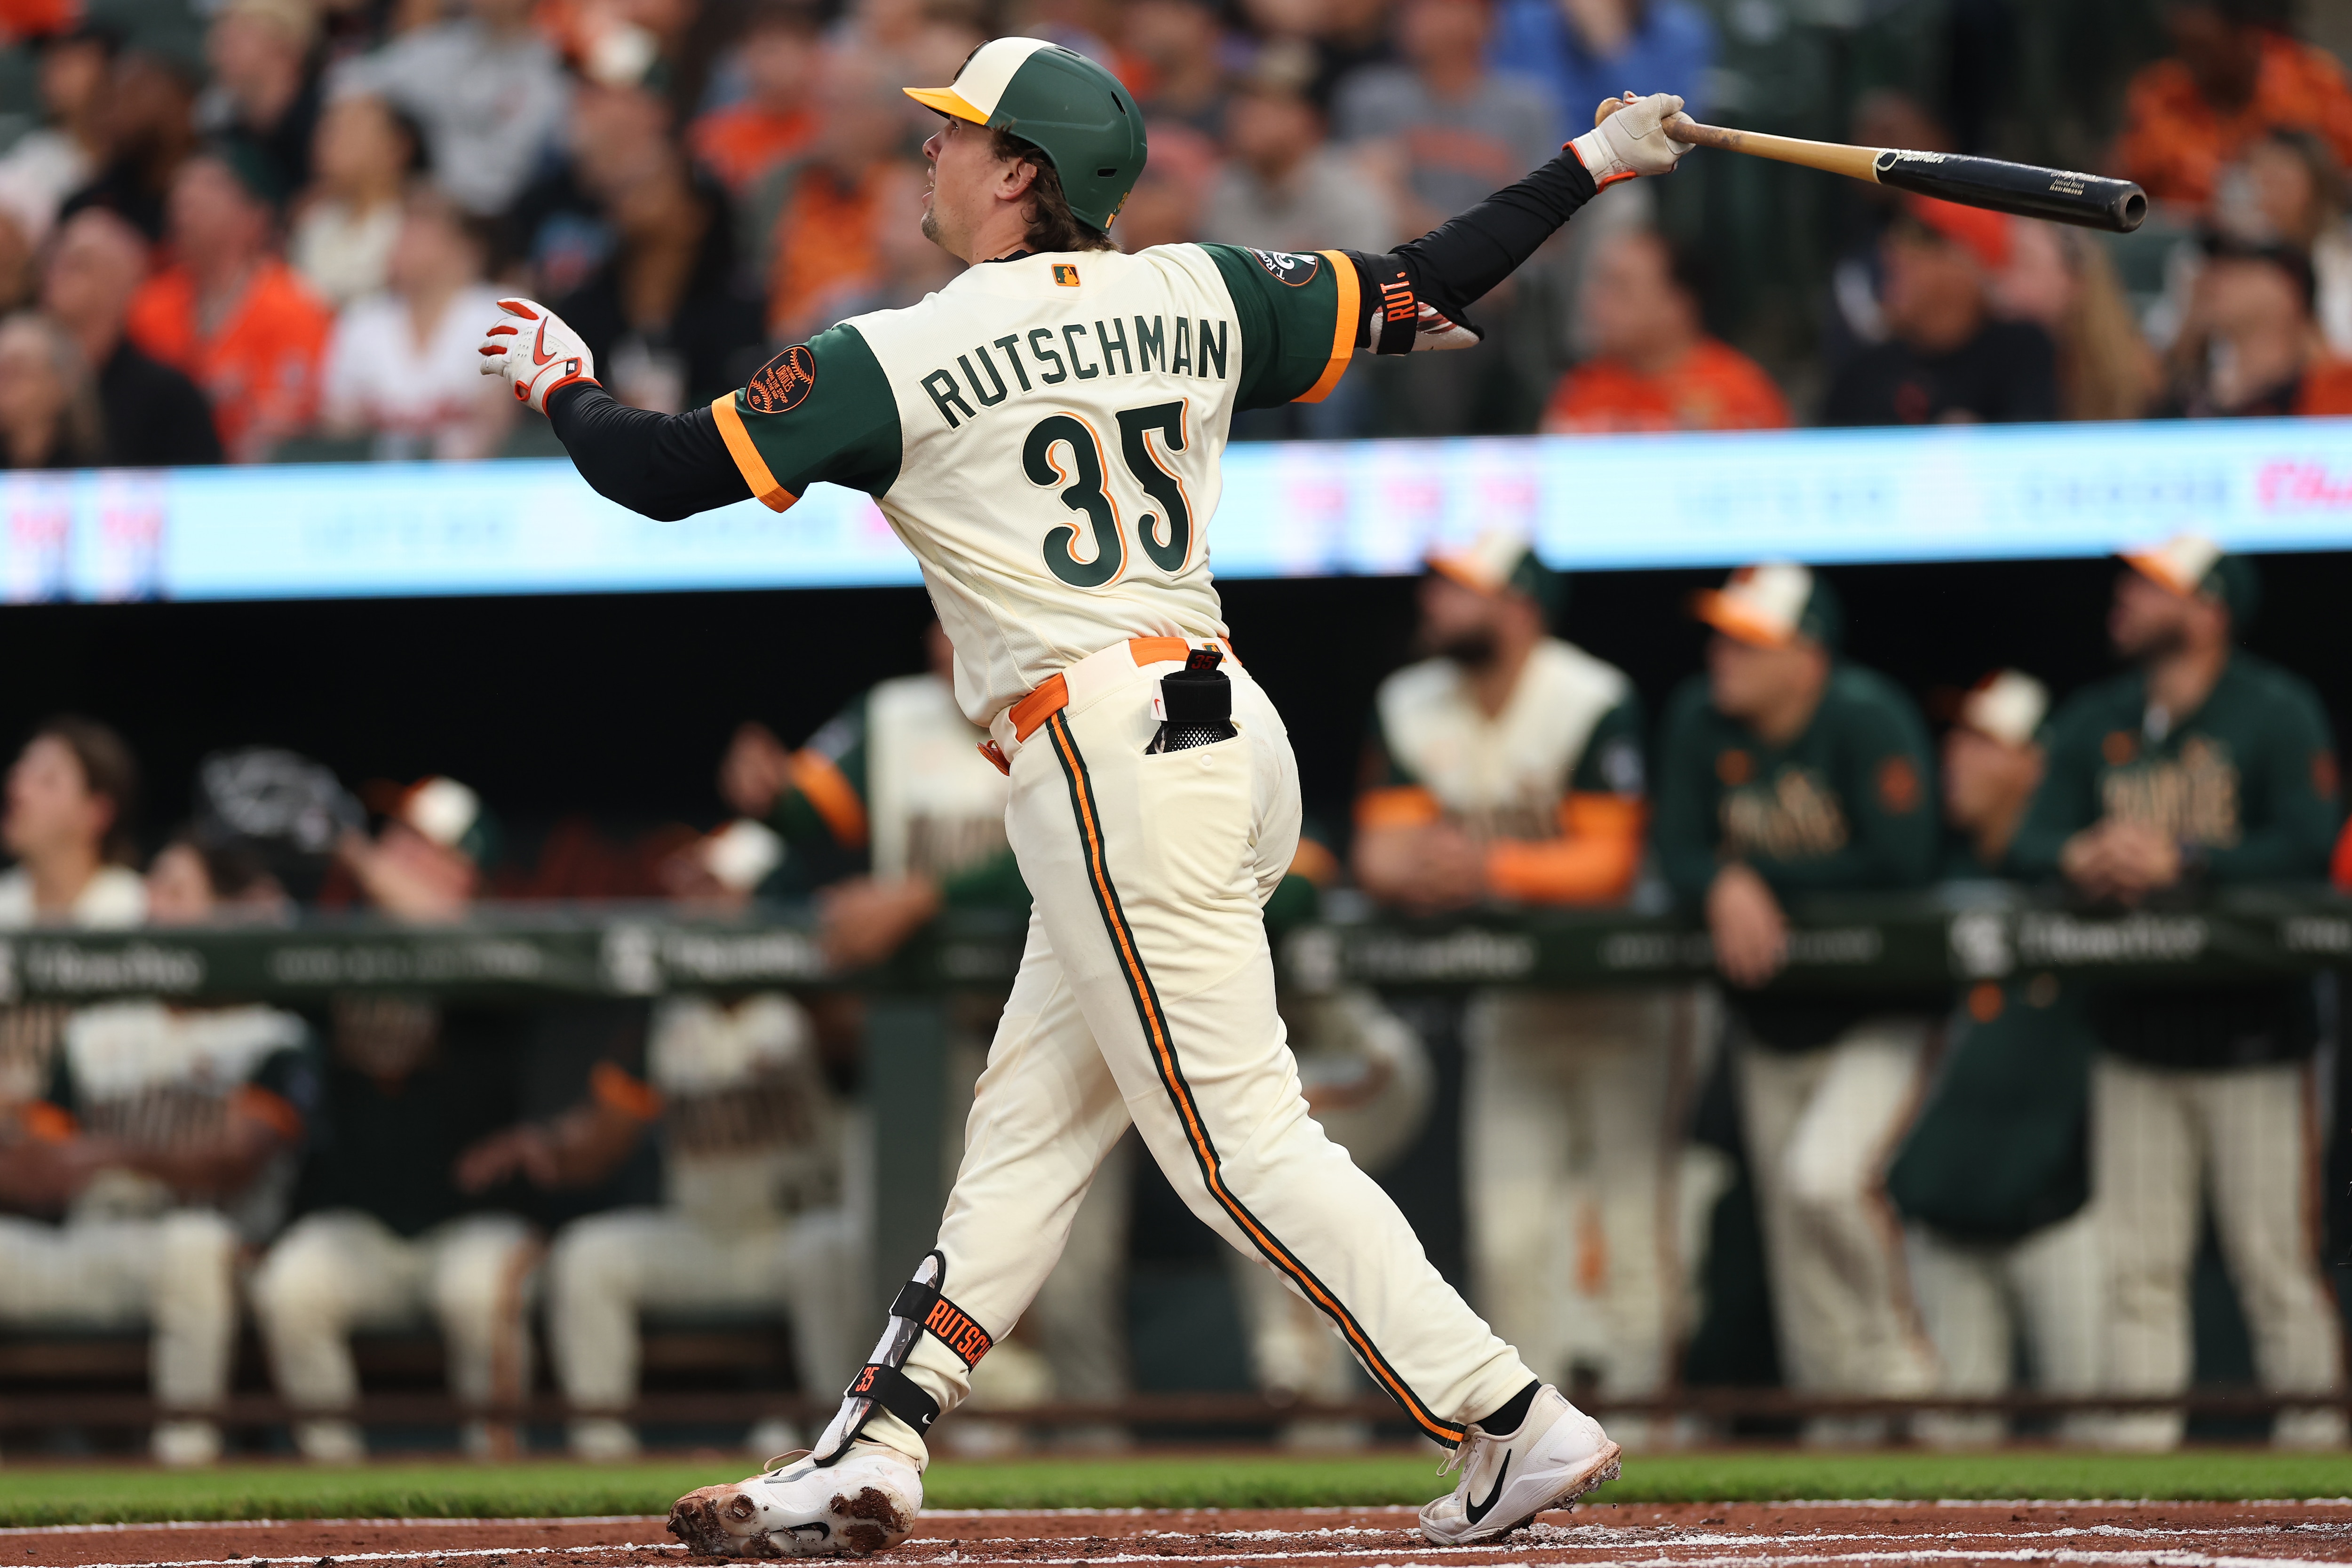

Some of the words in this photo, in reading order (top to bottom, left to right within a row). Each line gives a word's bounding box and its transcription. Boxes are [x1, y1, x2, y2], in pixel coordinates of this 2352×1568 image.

[1379, 271, 1415, 322] RUT.
[766, 367, 775, 381] FROM
[772, 378, 780, 390] THE
[777, 388, 788, 403] STOOP
[775, 364, 795, 392] ORIOLES
[919, 315, 1227, 430] RUTSCHMAN
[752, 395, 762, 405] 410
[1022, 397, 1194, 588] 35
[1191, 654, 1216, 670] 35
[855, 1366, 880, 1392] 35
